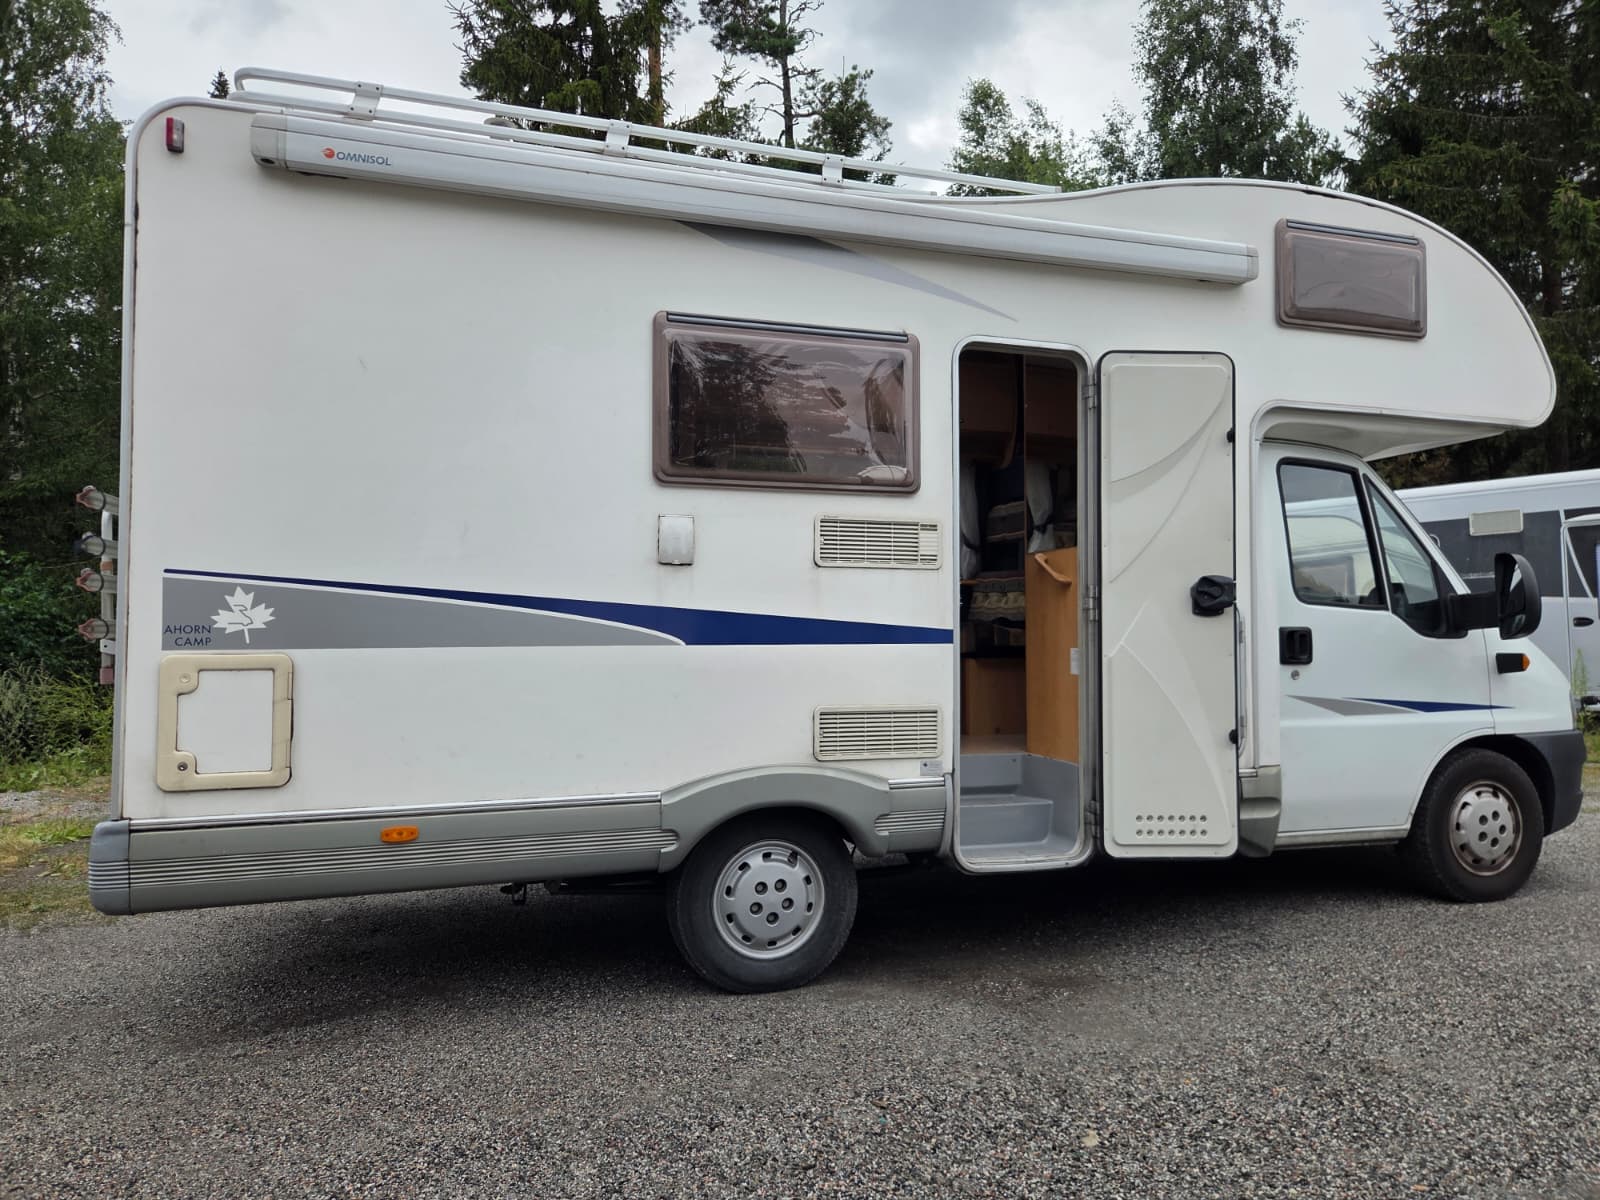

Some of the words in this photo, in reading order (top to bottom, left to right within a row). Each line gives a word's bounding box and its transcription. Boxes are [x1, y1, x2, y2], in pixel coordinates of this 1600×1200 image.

[336, 151, 392, 166] OMNISOL
[164, 624, 212, 635] AHORN
[174, 637, 212, 647] CAMP
